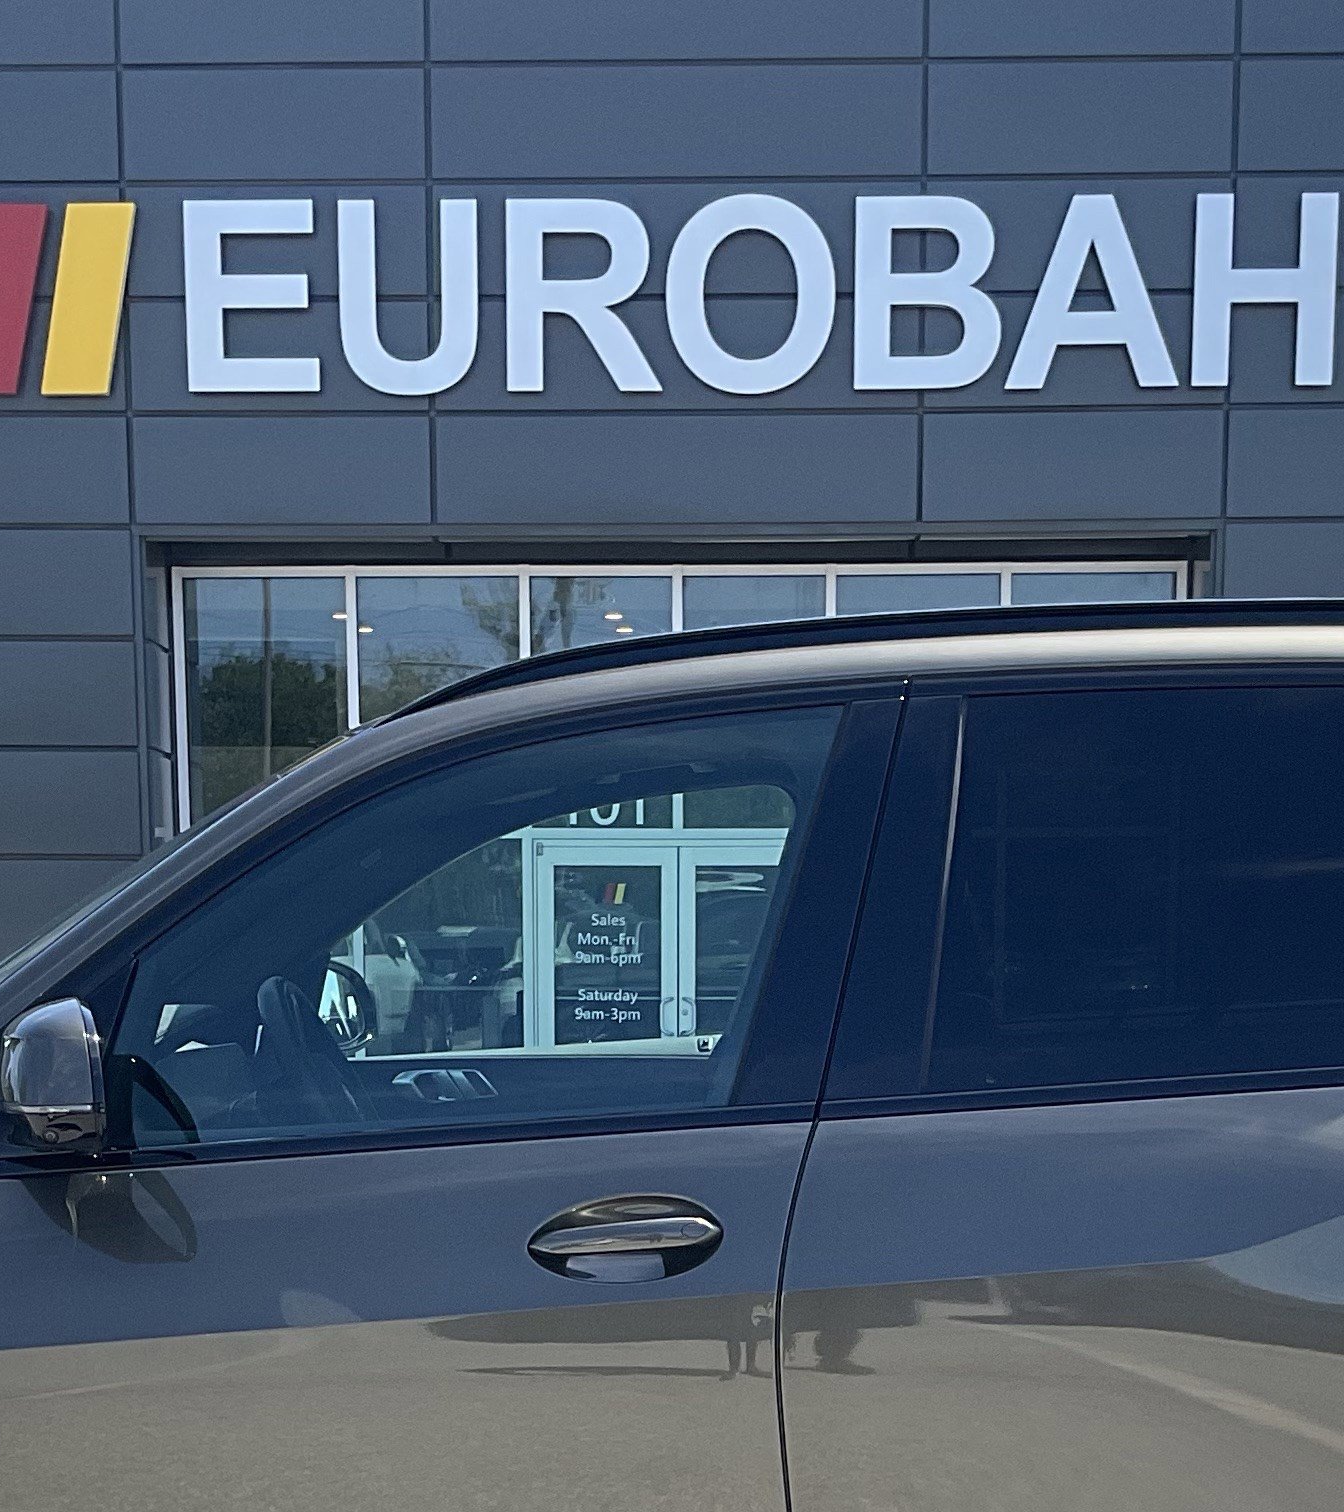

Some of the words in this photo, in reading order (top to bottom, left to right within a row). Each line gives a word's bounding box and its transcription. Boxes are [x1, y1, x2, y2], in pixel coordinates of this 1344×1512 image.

[591, 913, 626, 927] Sales
[575, 950, 642, 968] 9am-6pm
[577, 988, 639, 1005] Saturday
[574, 1006, 642, 1024] 9am-3pm
